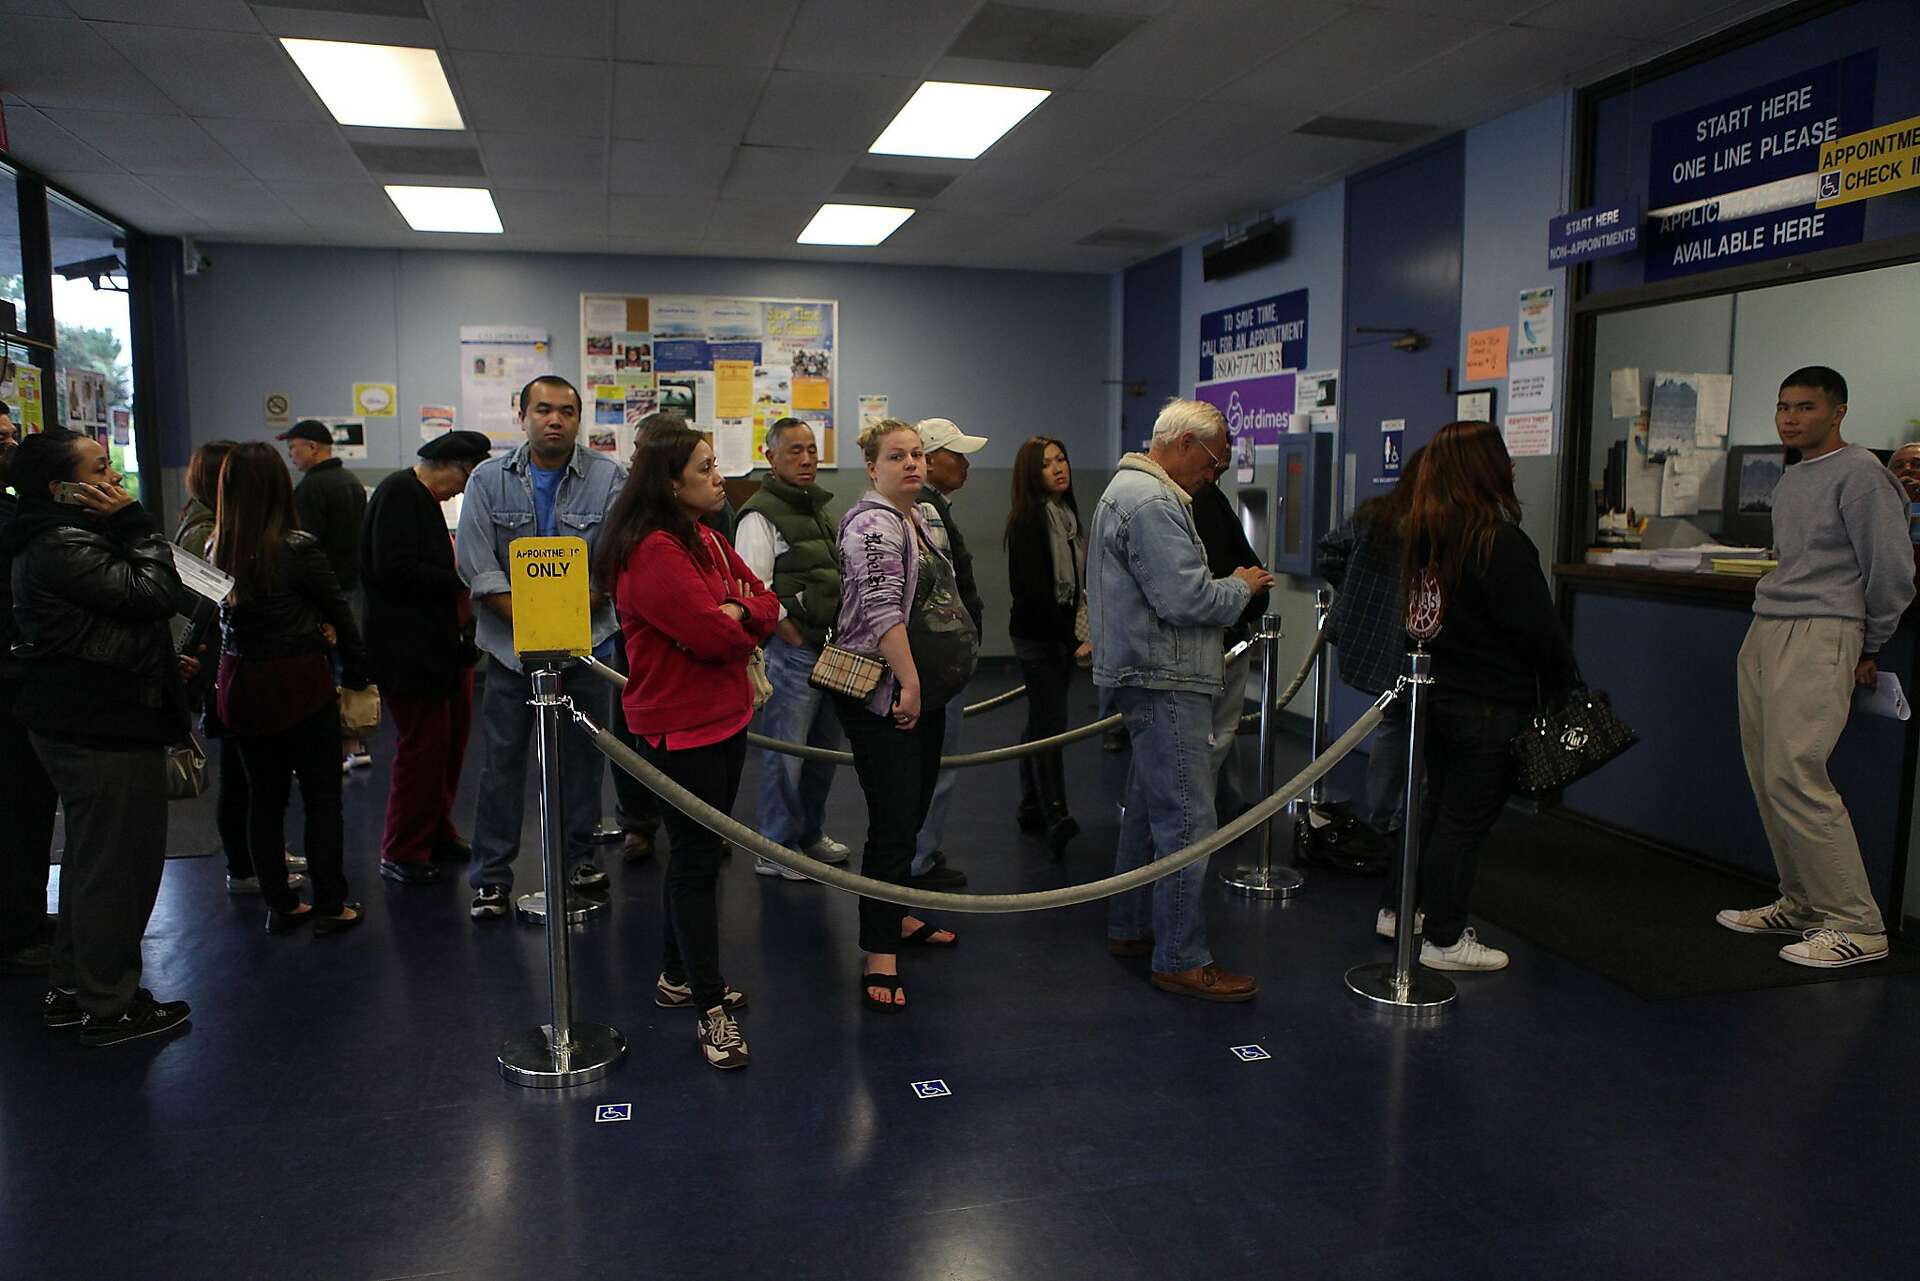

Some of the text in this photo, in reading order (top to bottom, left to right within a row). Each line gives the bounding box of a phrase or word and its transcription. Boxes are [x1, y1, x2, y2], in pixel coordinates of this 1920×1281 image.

[1696, 85, 1812, 143] START HERE
[1672, 117, 1838, 184] ONE LINE PLEASE
[1845, 160, 1903, 190] CHECK
[1566, 208, 1619, 236] START HERE
[1550, 227, 1636, 260] NON-APPOINTMENTS
[1672, 213, 1825, 266] AVAILABLE HERE
[1223, 314, 1234, 332] TO
[1235, 308, 1254, 329] SAVE
[1202, 319, 1305, 358] CALL FOR AN APPOINTMENT
[526, 561, 571, 578] ONLY
